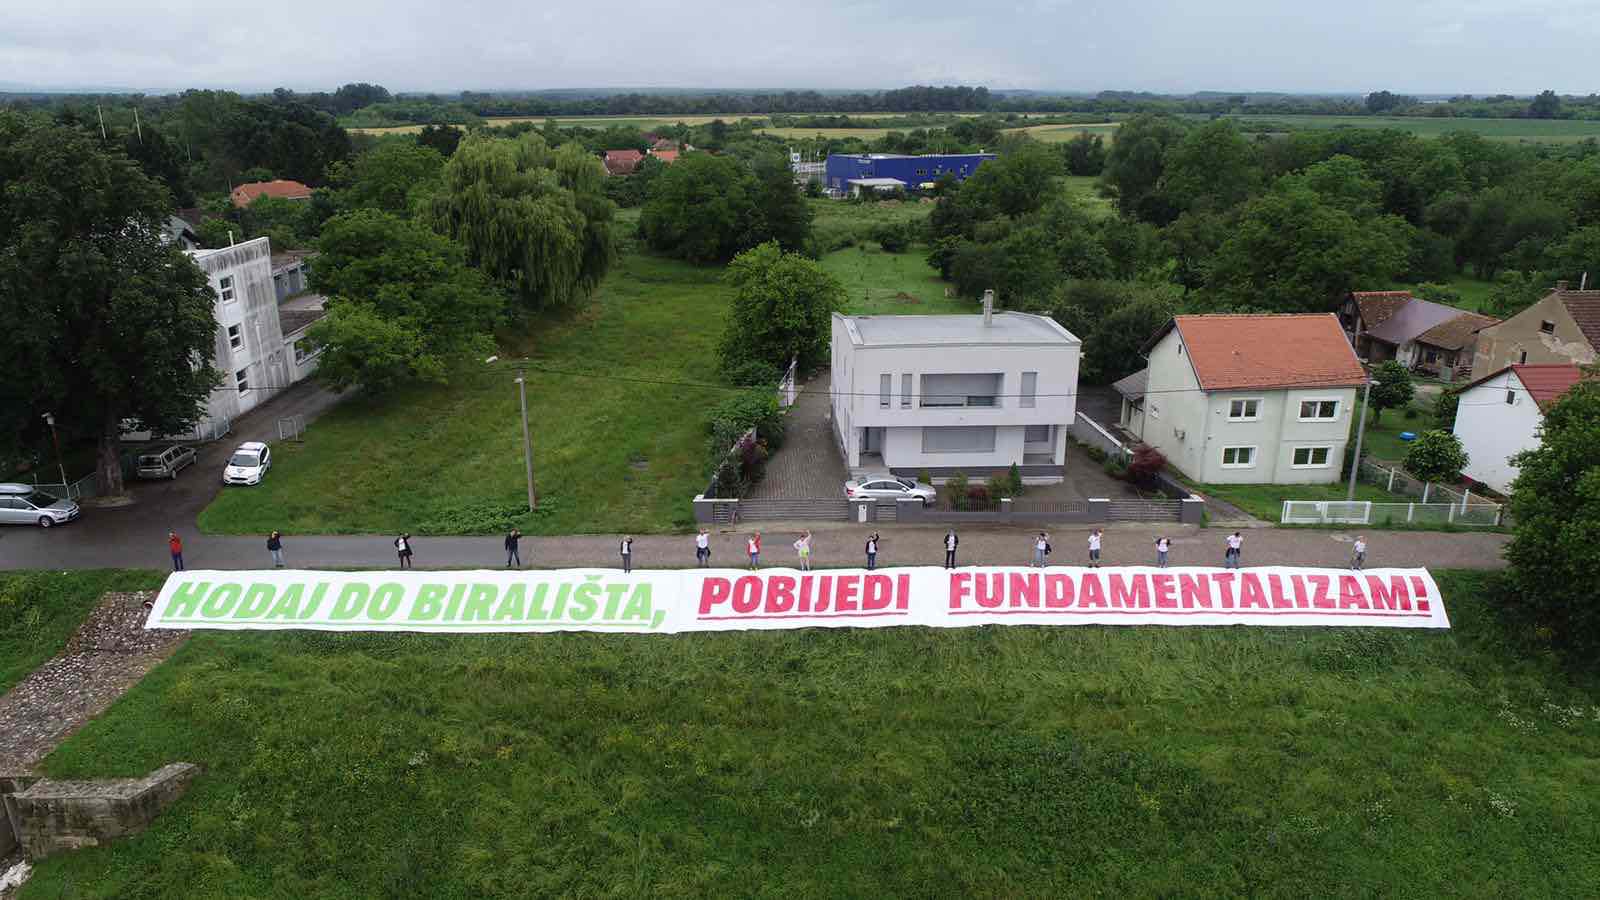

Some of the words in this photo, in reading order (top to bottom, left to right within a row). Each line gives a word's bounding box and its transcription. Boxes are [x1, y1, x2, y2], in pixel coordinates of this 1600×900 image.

[162, 581, 330, 620] HODAJ
[328, 583, 405, 621] DO
[408, 574, 667, 629] BIRALIŠTA,
[697, 575, 910, 615] POBIJEDI
[948, 573, 1430, 612] FUNDAMENTALIZAM!
